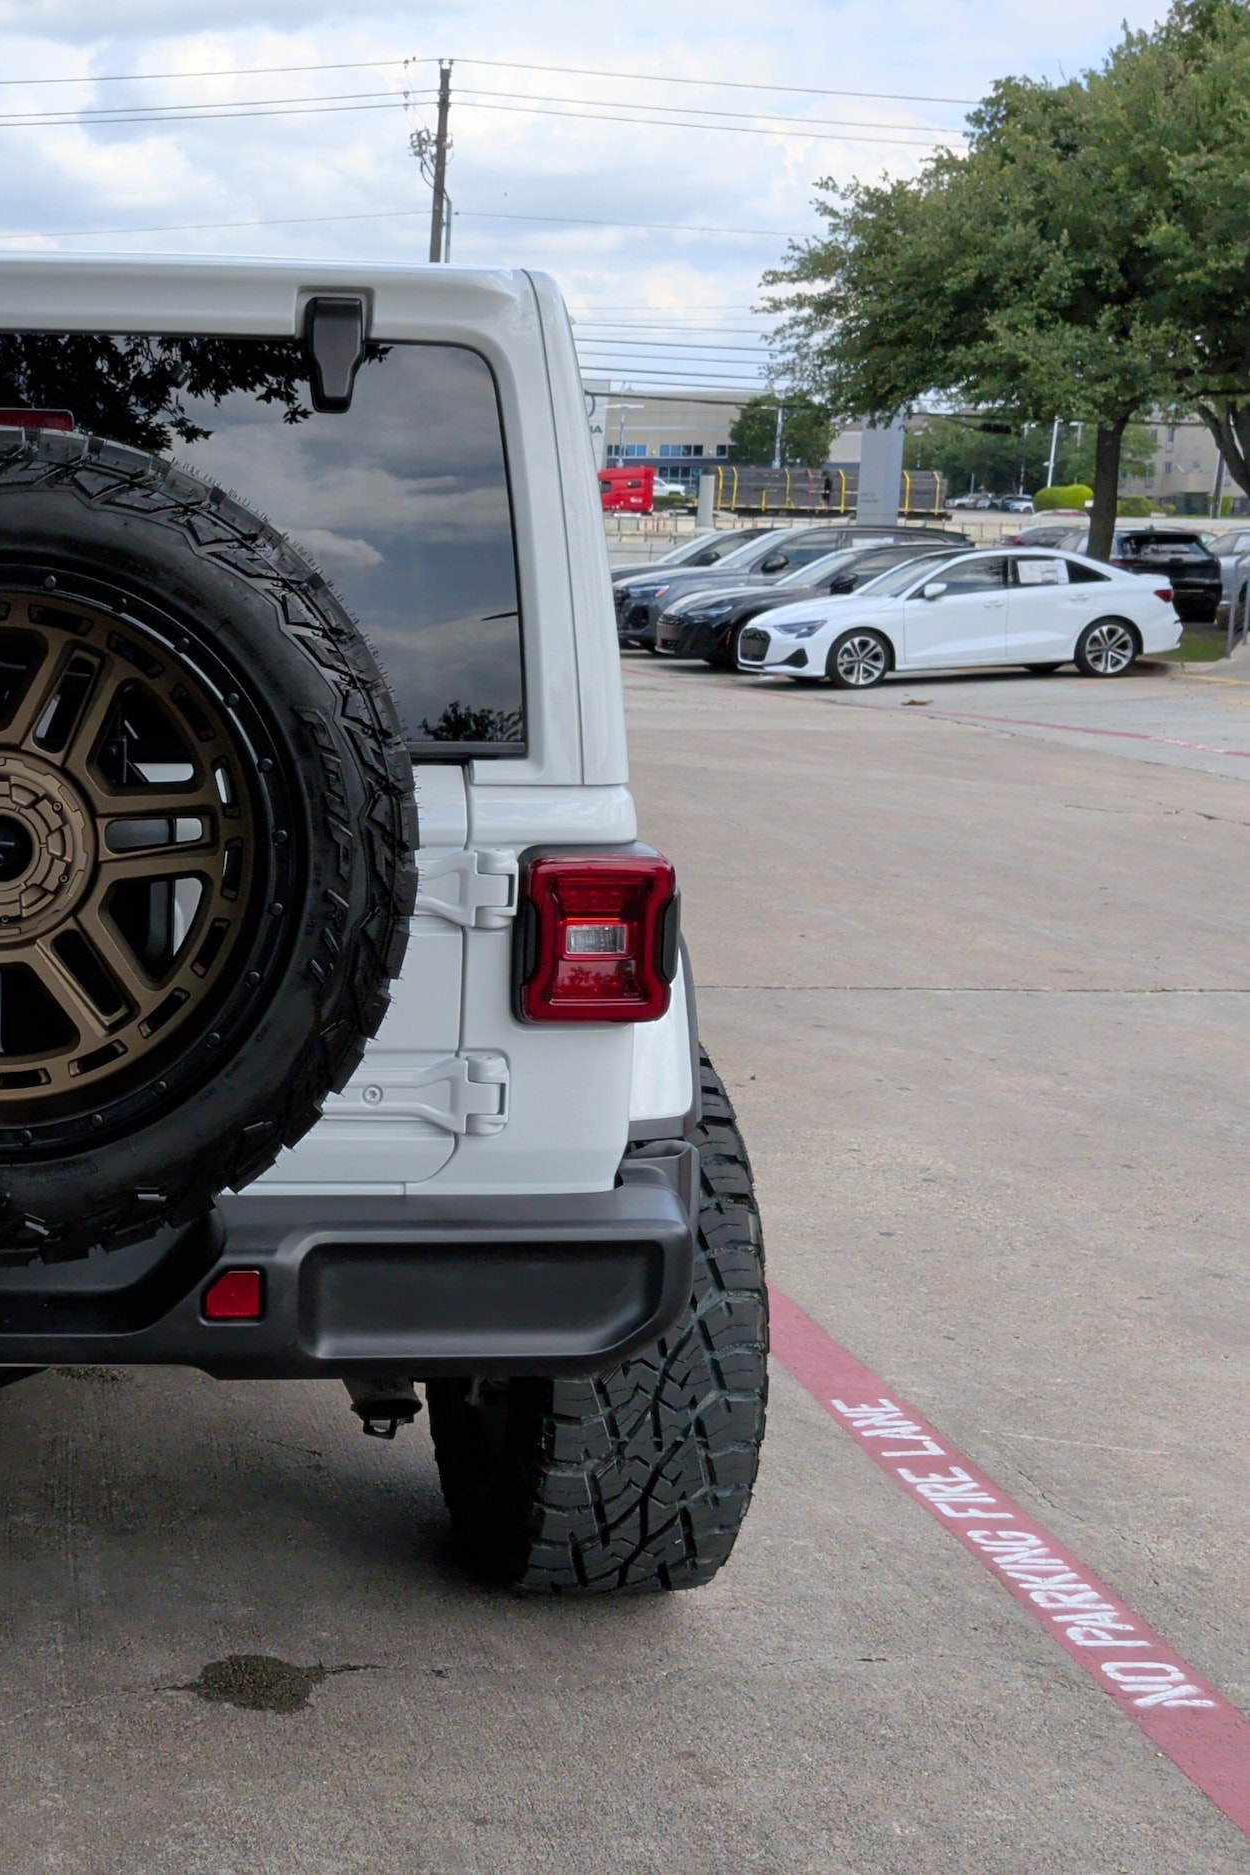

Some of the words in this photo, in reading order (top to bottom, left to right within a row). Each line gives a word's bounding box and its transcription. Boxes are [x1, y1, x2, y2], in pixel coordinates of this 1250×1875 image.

[831, 1397, 947, 1458] LANE
[897, 1465, 1015, 1520] FIRE
[966, 1529, 1153, 1648] PARKING
[1100, 1660, 1217, 1709] NO
